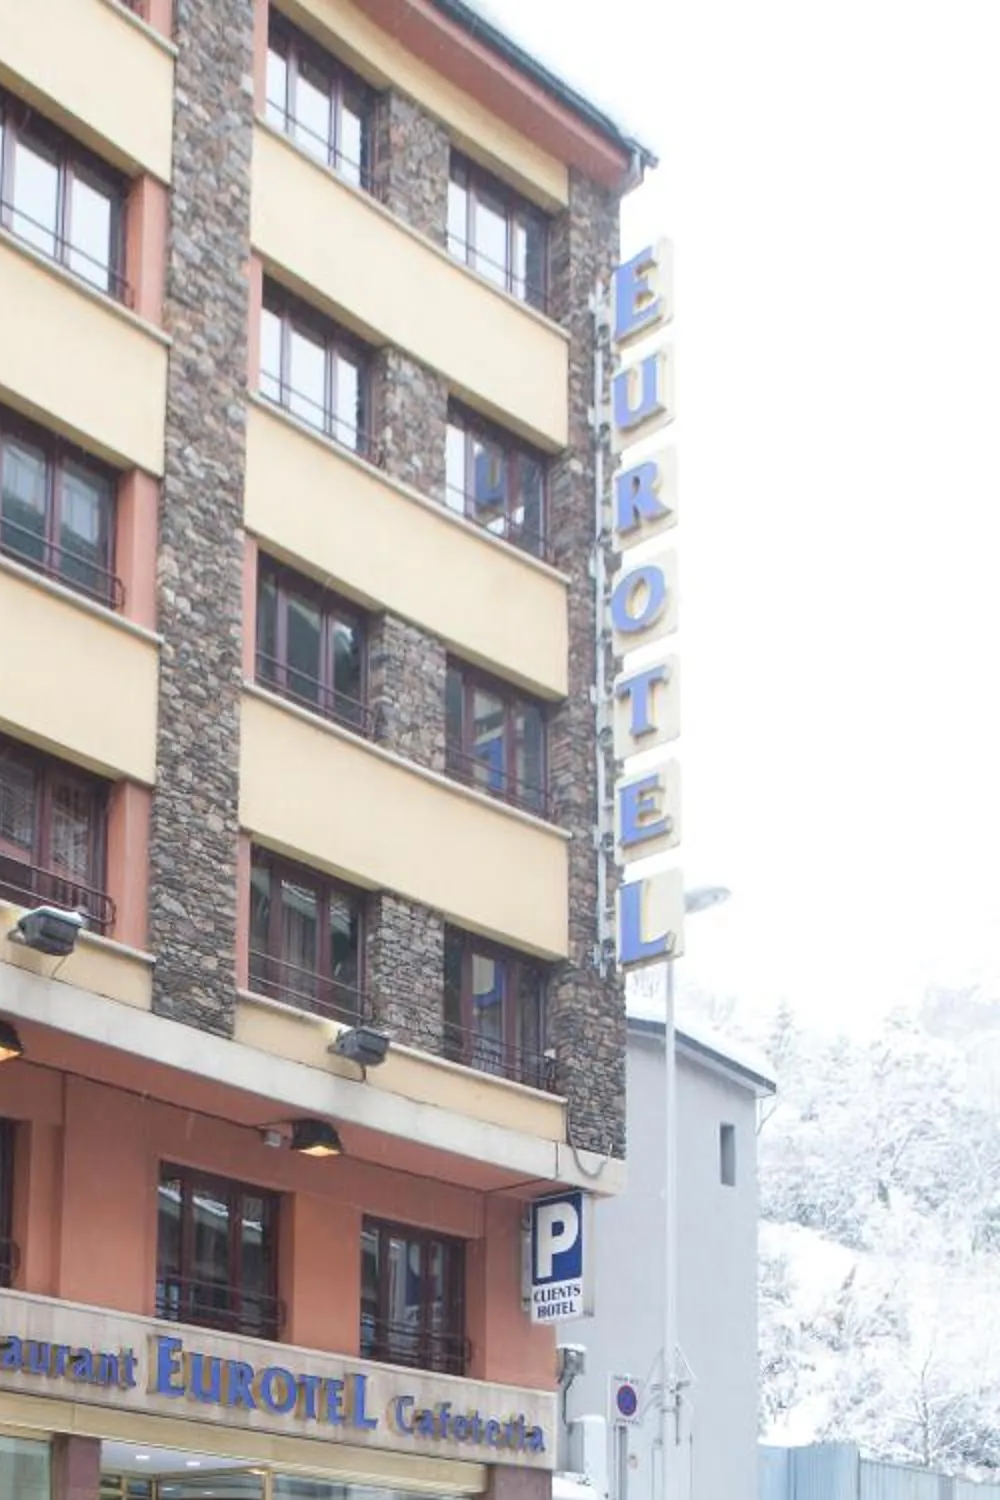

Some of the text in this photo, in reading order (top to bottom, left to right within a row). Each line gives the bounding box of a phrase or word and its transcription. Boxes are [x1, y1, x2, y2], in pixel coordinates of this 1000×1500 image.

[611, 246, 673, 965] EUROTEL
[536, 1202, 579, 1279] P
[533, 1284, 581, 1303] CLIENTS
[537, 1300, 577, 1318] HOTEL
[386, 1395, 547, 1453] Cafeteria
